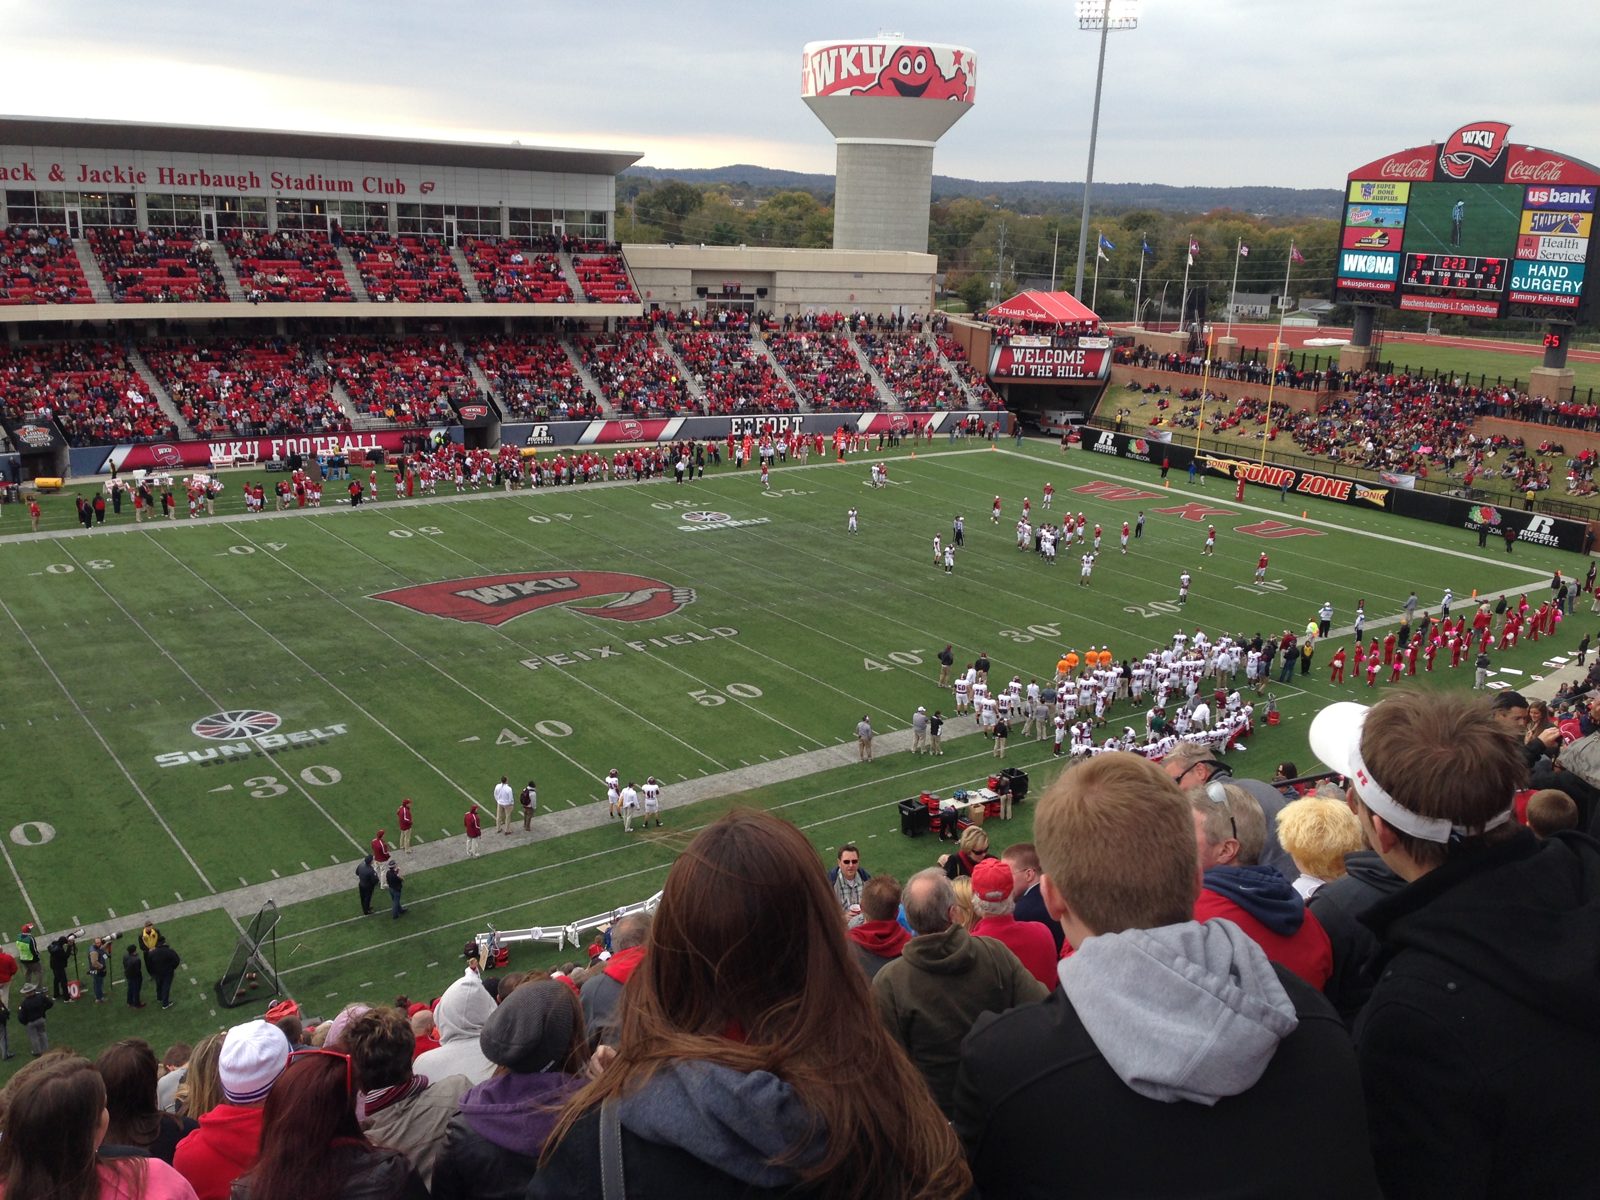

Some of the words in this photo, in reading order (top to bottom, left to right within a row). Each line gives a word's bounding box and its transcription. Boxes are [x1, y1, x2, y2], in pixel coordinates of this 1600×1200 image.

[812, 46, 883, 92] WKU
[1462, 130, 1495, 149] WKU
[48, 163, 65, 182] &
[77, 164, 147, 184] Jackie
[158, 166, 260, 191] Harbaugh
[271, 171, 353, 193] Stadium
[363, 176, 406, 195] Club
[1541, 238, 1579, 249] Health
[1518, 248, 1537, 258] WKU
[1539, 249, 1586, 262] Services
[1442, 257, 1467, 269] 2:23
[1528, 264, 1569, 278] HAND
[1342, 279, 1391, 289] wkusports.com
[1511, 277, 1583, 293] SURGERY
[1401, 297, 1424, 306] Houchens
[1460, 303, 1475, 312] Smith
[1475, 304, 1498, 314] Stadium
[1512, 292, 1537, 302] Jimmy
[1555, 296, 1575, 304] Field
[998, 306, 1025, 316] STEAMER
[1544, 334, 1559, 347] 25
[1012, 348, 1086, 364] WELCOME
[1010, 364, 1026, 376] TO
[1029, 365, 1053, 377] THE
[1056, 365, 1084, 378] HILL
[209, 441, 259, 460] WKU
[1094, 443, 1118, 453] RUSSELL
[1234, 461, 1295, 488] SONIC
[1296, 473, 1353, 500] ZONE
[1357, 489, 1385, 500] SONIC
[528, 512, 574, 524] 40
[388, 526, 445, 538] 50
[1519, 529, 1559, 543] RUSSELL
[228, 541, 288, 555] 40
[1517, 535, 1558, 547] ATHLETIC
[46, 559, 115, 574] 30
[455, 577, 578, 604] WKU
[1123, 601, 1182, 618] 20
[998, 624, 1062, 643] 30
[519, 645, 623, 670] FEIX
[625, 627, 739, 652] FIELD
[864, 652, 923, 672] 40
[687, 683, 763, 706] 50
[496, 720, 574, 747] 40
[154, 742, 252, 767] SUN
[254, 723, 348, 749] BELT
[243, 765, 342, 798] 30
